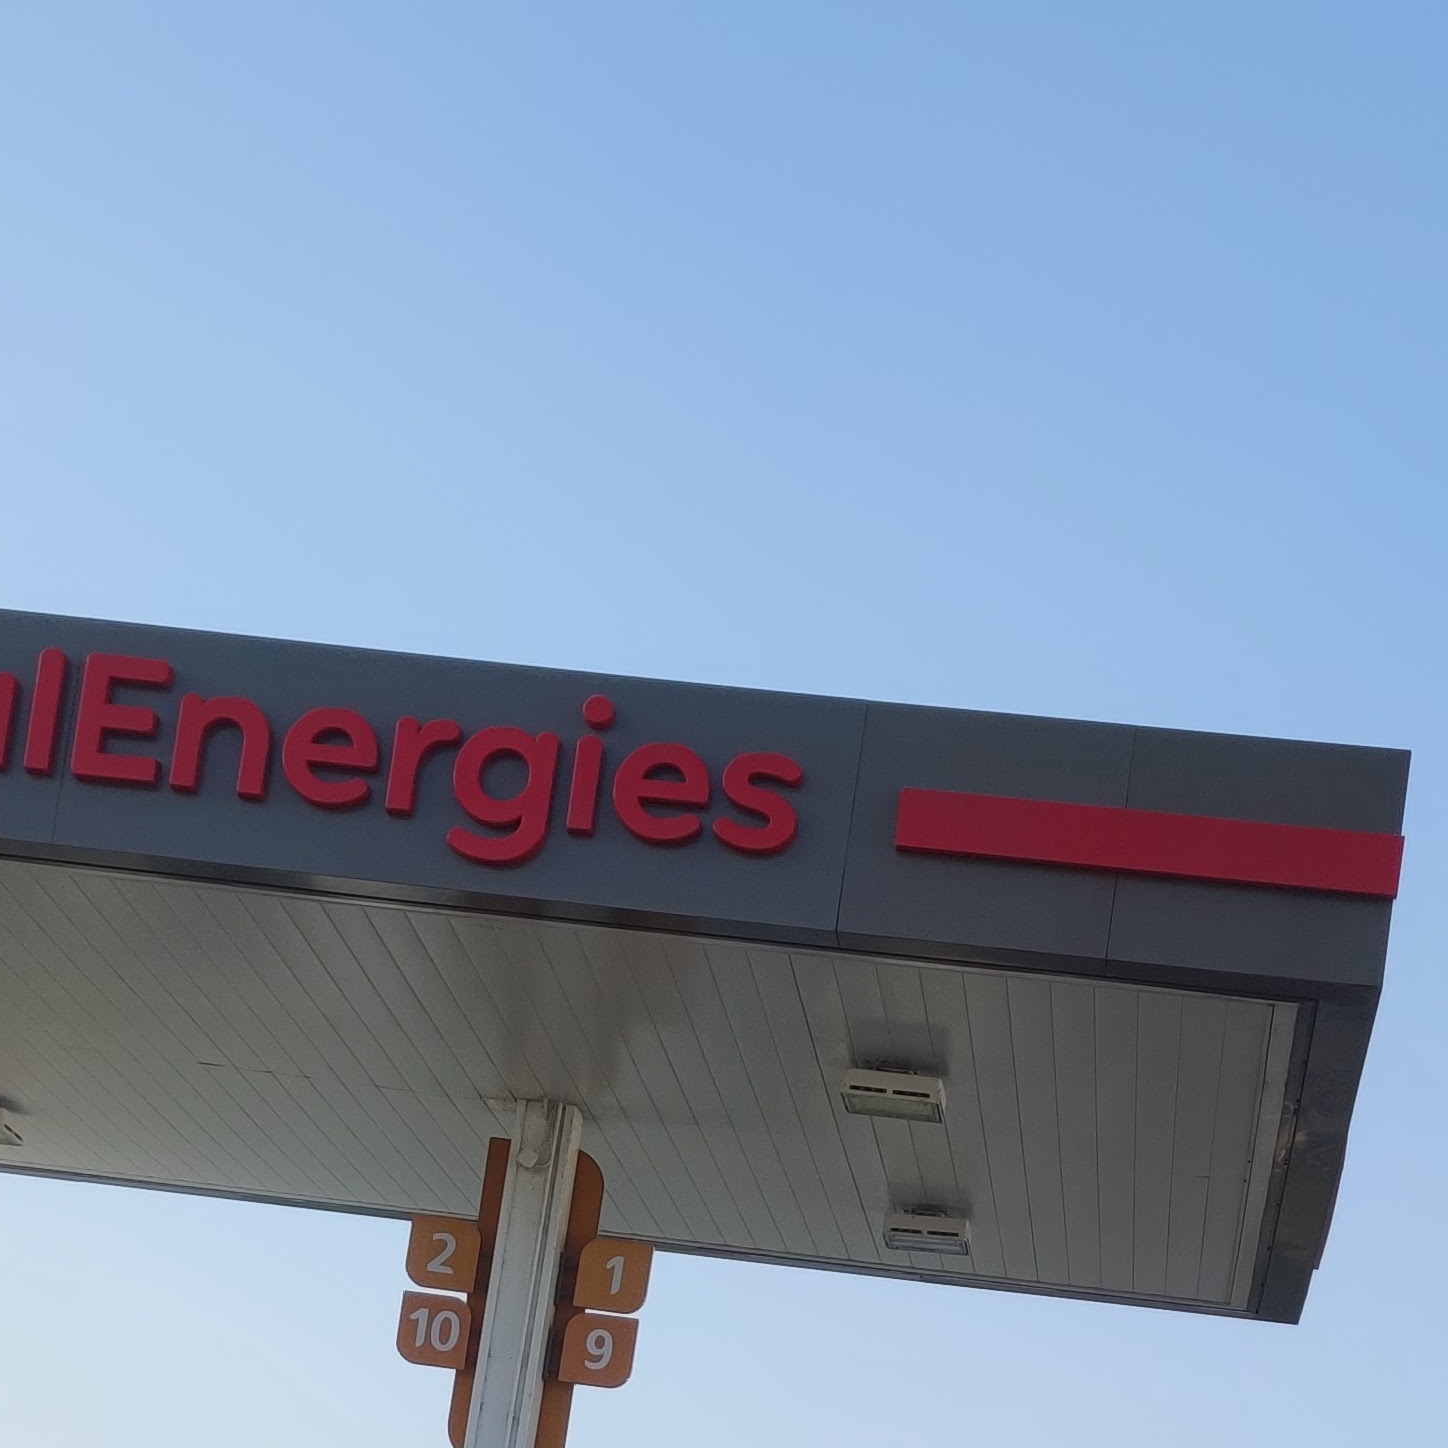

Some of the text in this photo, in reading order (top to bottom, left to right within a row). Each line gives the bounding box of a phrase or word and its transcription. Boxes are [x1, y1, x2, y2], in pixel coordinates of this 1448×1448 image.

[426, 1232, 457, 1275] 2
[605, 1255, 625, 1295] 1
[409, 1307, 460, 1352] 10
[583, 1328, 613, 1370] 9
